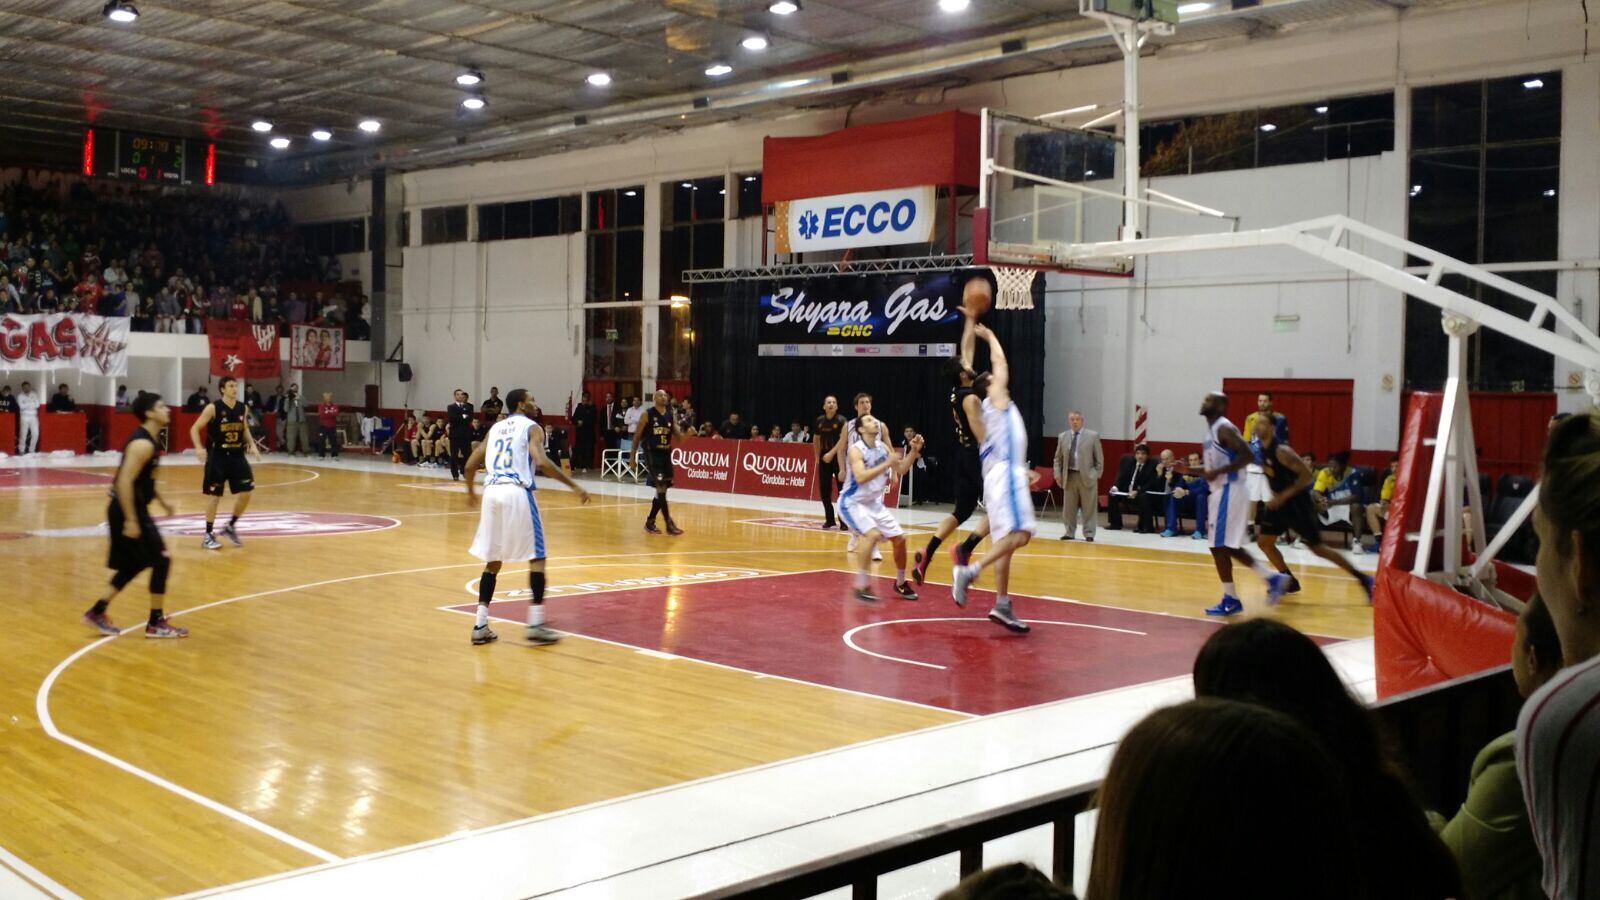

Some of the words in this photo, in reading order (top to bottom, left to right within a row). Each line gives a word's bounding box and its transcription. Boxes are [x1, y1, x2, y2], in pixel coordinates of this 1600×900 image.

[821, 198, 917, 239] ECCO
[765, 285, 871, 335] Shyara
[884, 281, 948, 336] Gas
[840, 323, 874, 337] GNC
[493, 437, 514, 470] 23
[671, 447, 730, 470] QUORUM
[743, 452, 808, 476] QUORUM
[687, 467, 709, 480] Córdoba
[713, 470, 728, 481] Hotel
[761, 473, 785, 486] Córdoba
[789, 476, 806, 487] Hotel
